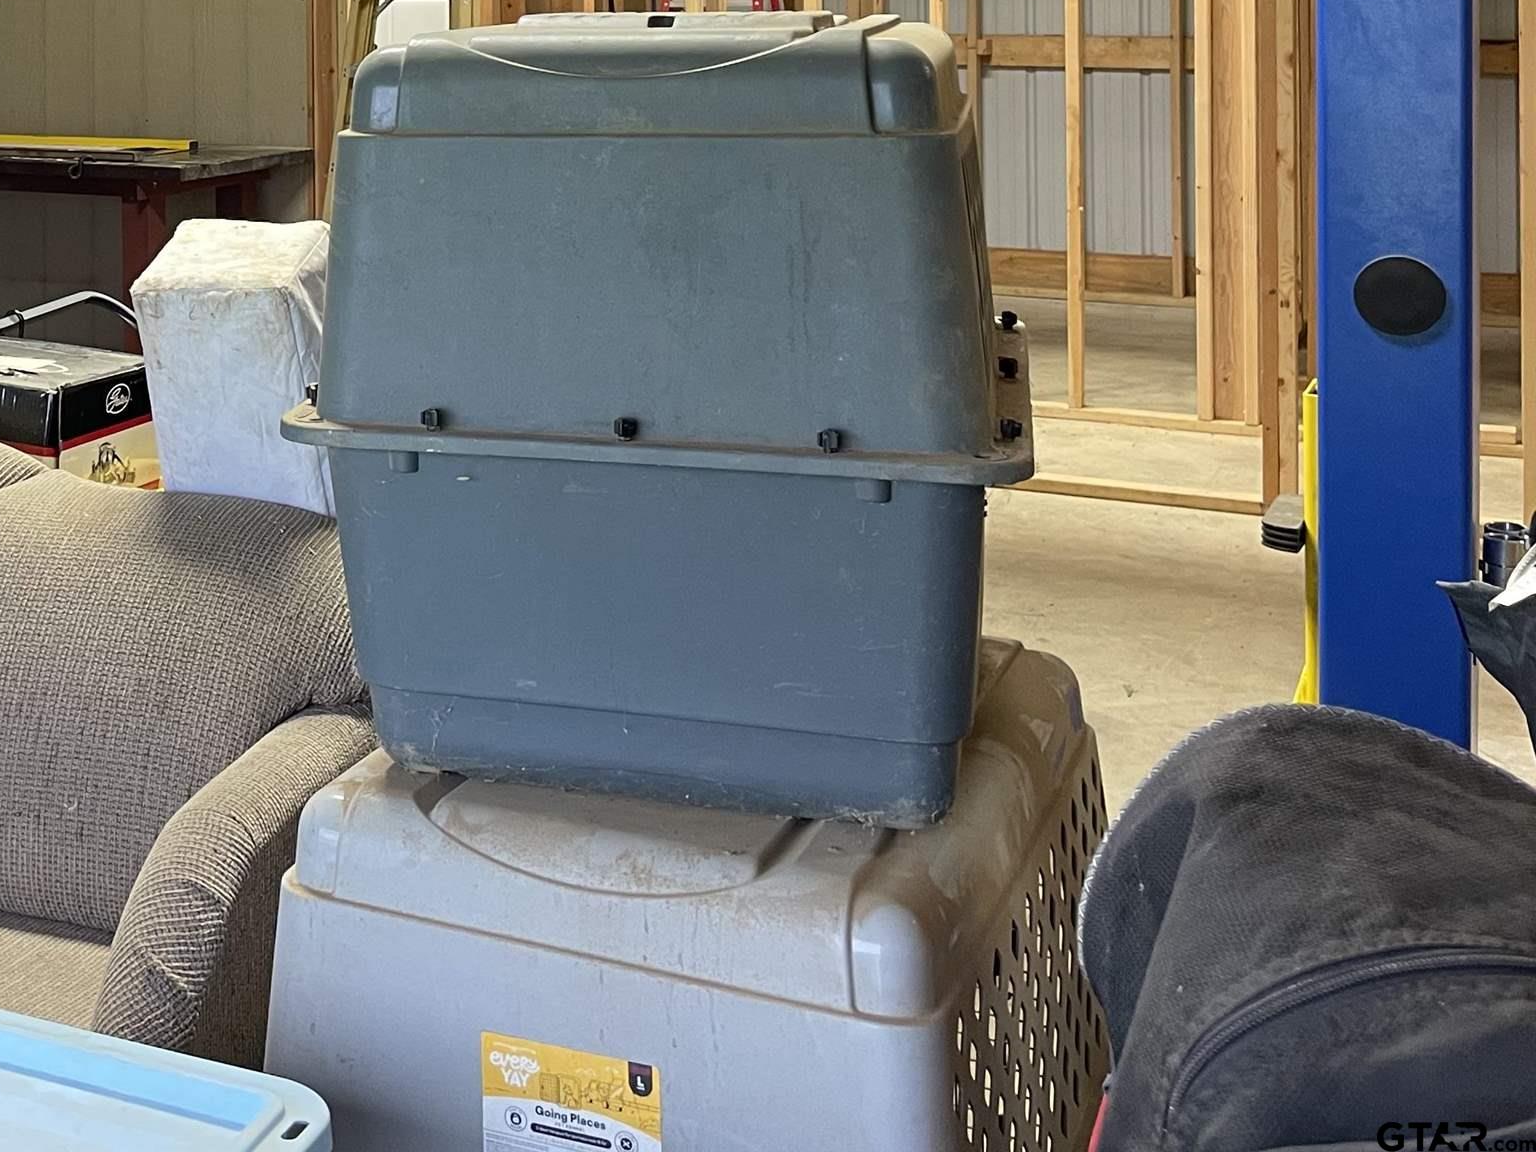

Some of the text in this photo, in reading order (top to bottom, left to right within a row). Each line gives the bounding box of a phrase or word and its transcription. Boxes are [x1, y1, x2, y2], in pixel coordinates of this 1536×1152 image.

[500, 1068, 530, 1088] YAY
[535, 1105, 568, 1123] Going
[570, 1113, 606, 1130] Places
